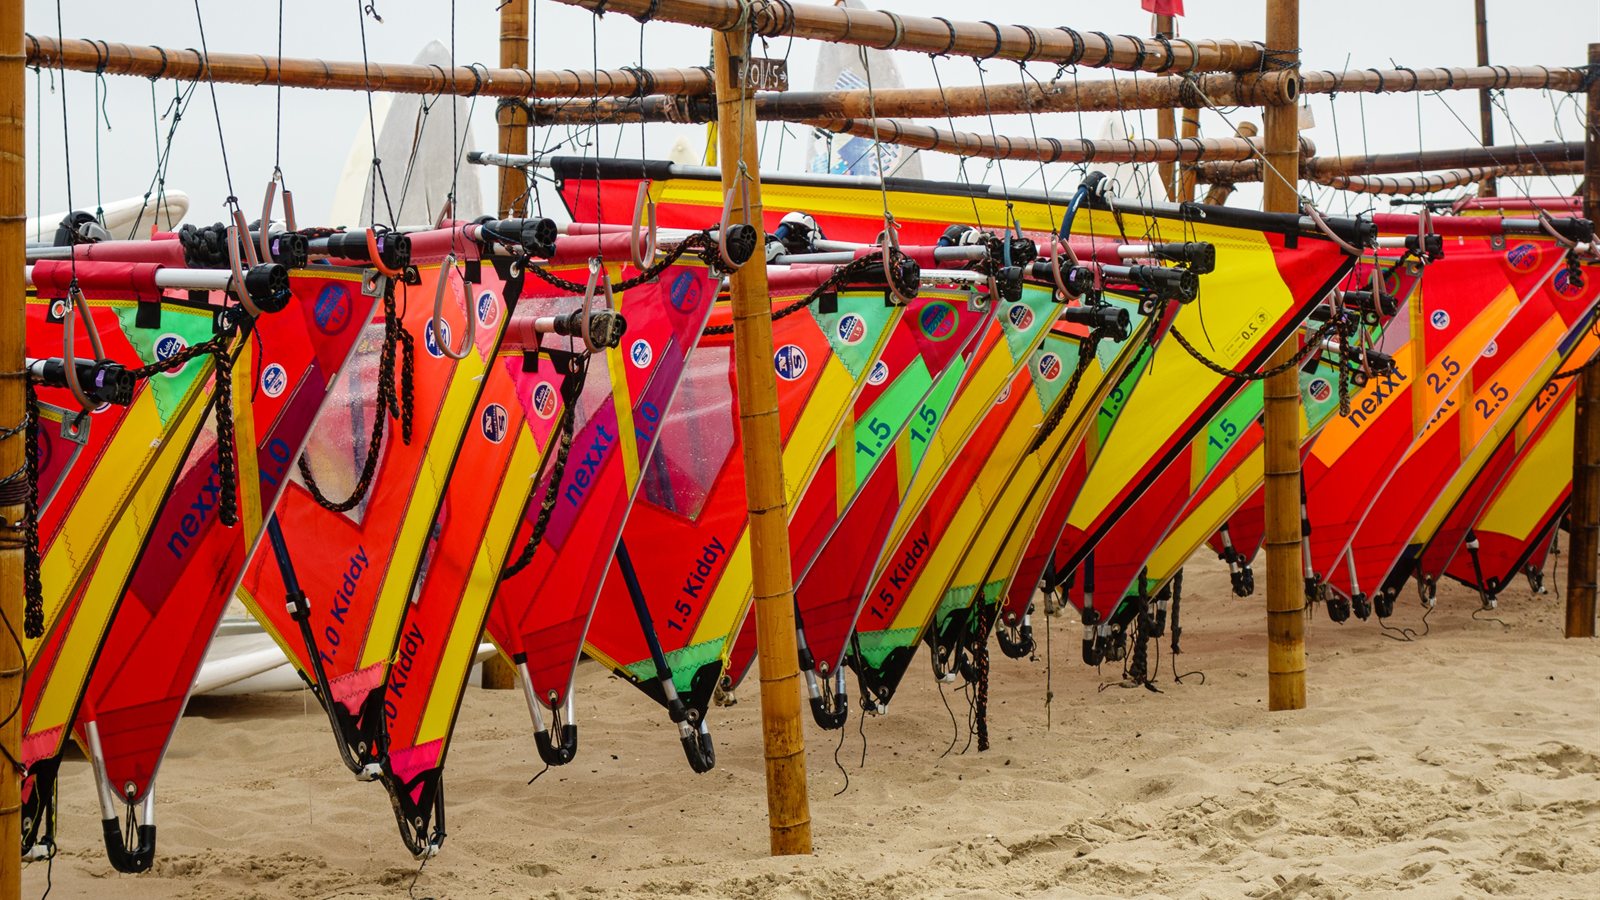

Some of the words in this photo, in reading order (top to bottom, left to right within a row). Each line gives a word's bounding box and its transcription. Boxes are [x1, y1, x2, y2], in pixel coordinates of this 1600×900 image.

[157, 339, 174, 358] Kiddy
[911, 403, 937, 443] 1.5
[1098, 388, 1124, 419] 1.5
[1348, 366, 1408, 429] nexxt
[1426, 355, 1461, 395] 2.5
[1475, 381, 1509, 420] 2.5
[564, 425, 614, 507] nexxt
[634, 402, 660, 442] 1.0
[856, 417, 892, 458] 1.5
[1209, 418, 1237, 450] 1.5
[167, 461, 220, 560] nexx
[259, 438, 290, 486] 1.0
[319, 626, 340, 666] 1.0
[330, 545, 369, 625] Kiddy
[667, 599, 692, 631] 1.5
[682, 536, 726, 599] Kiddy
[871, 588, 894, 619] 1.5
[889, 532, 930, 590] Kiddy
[389, 622, 425, 699] Kiddy
